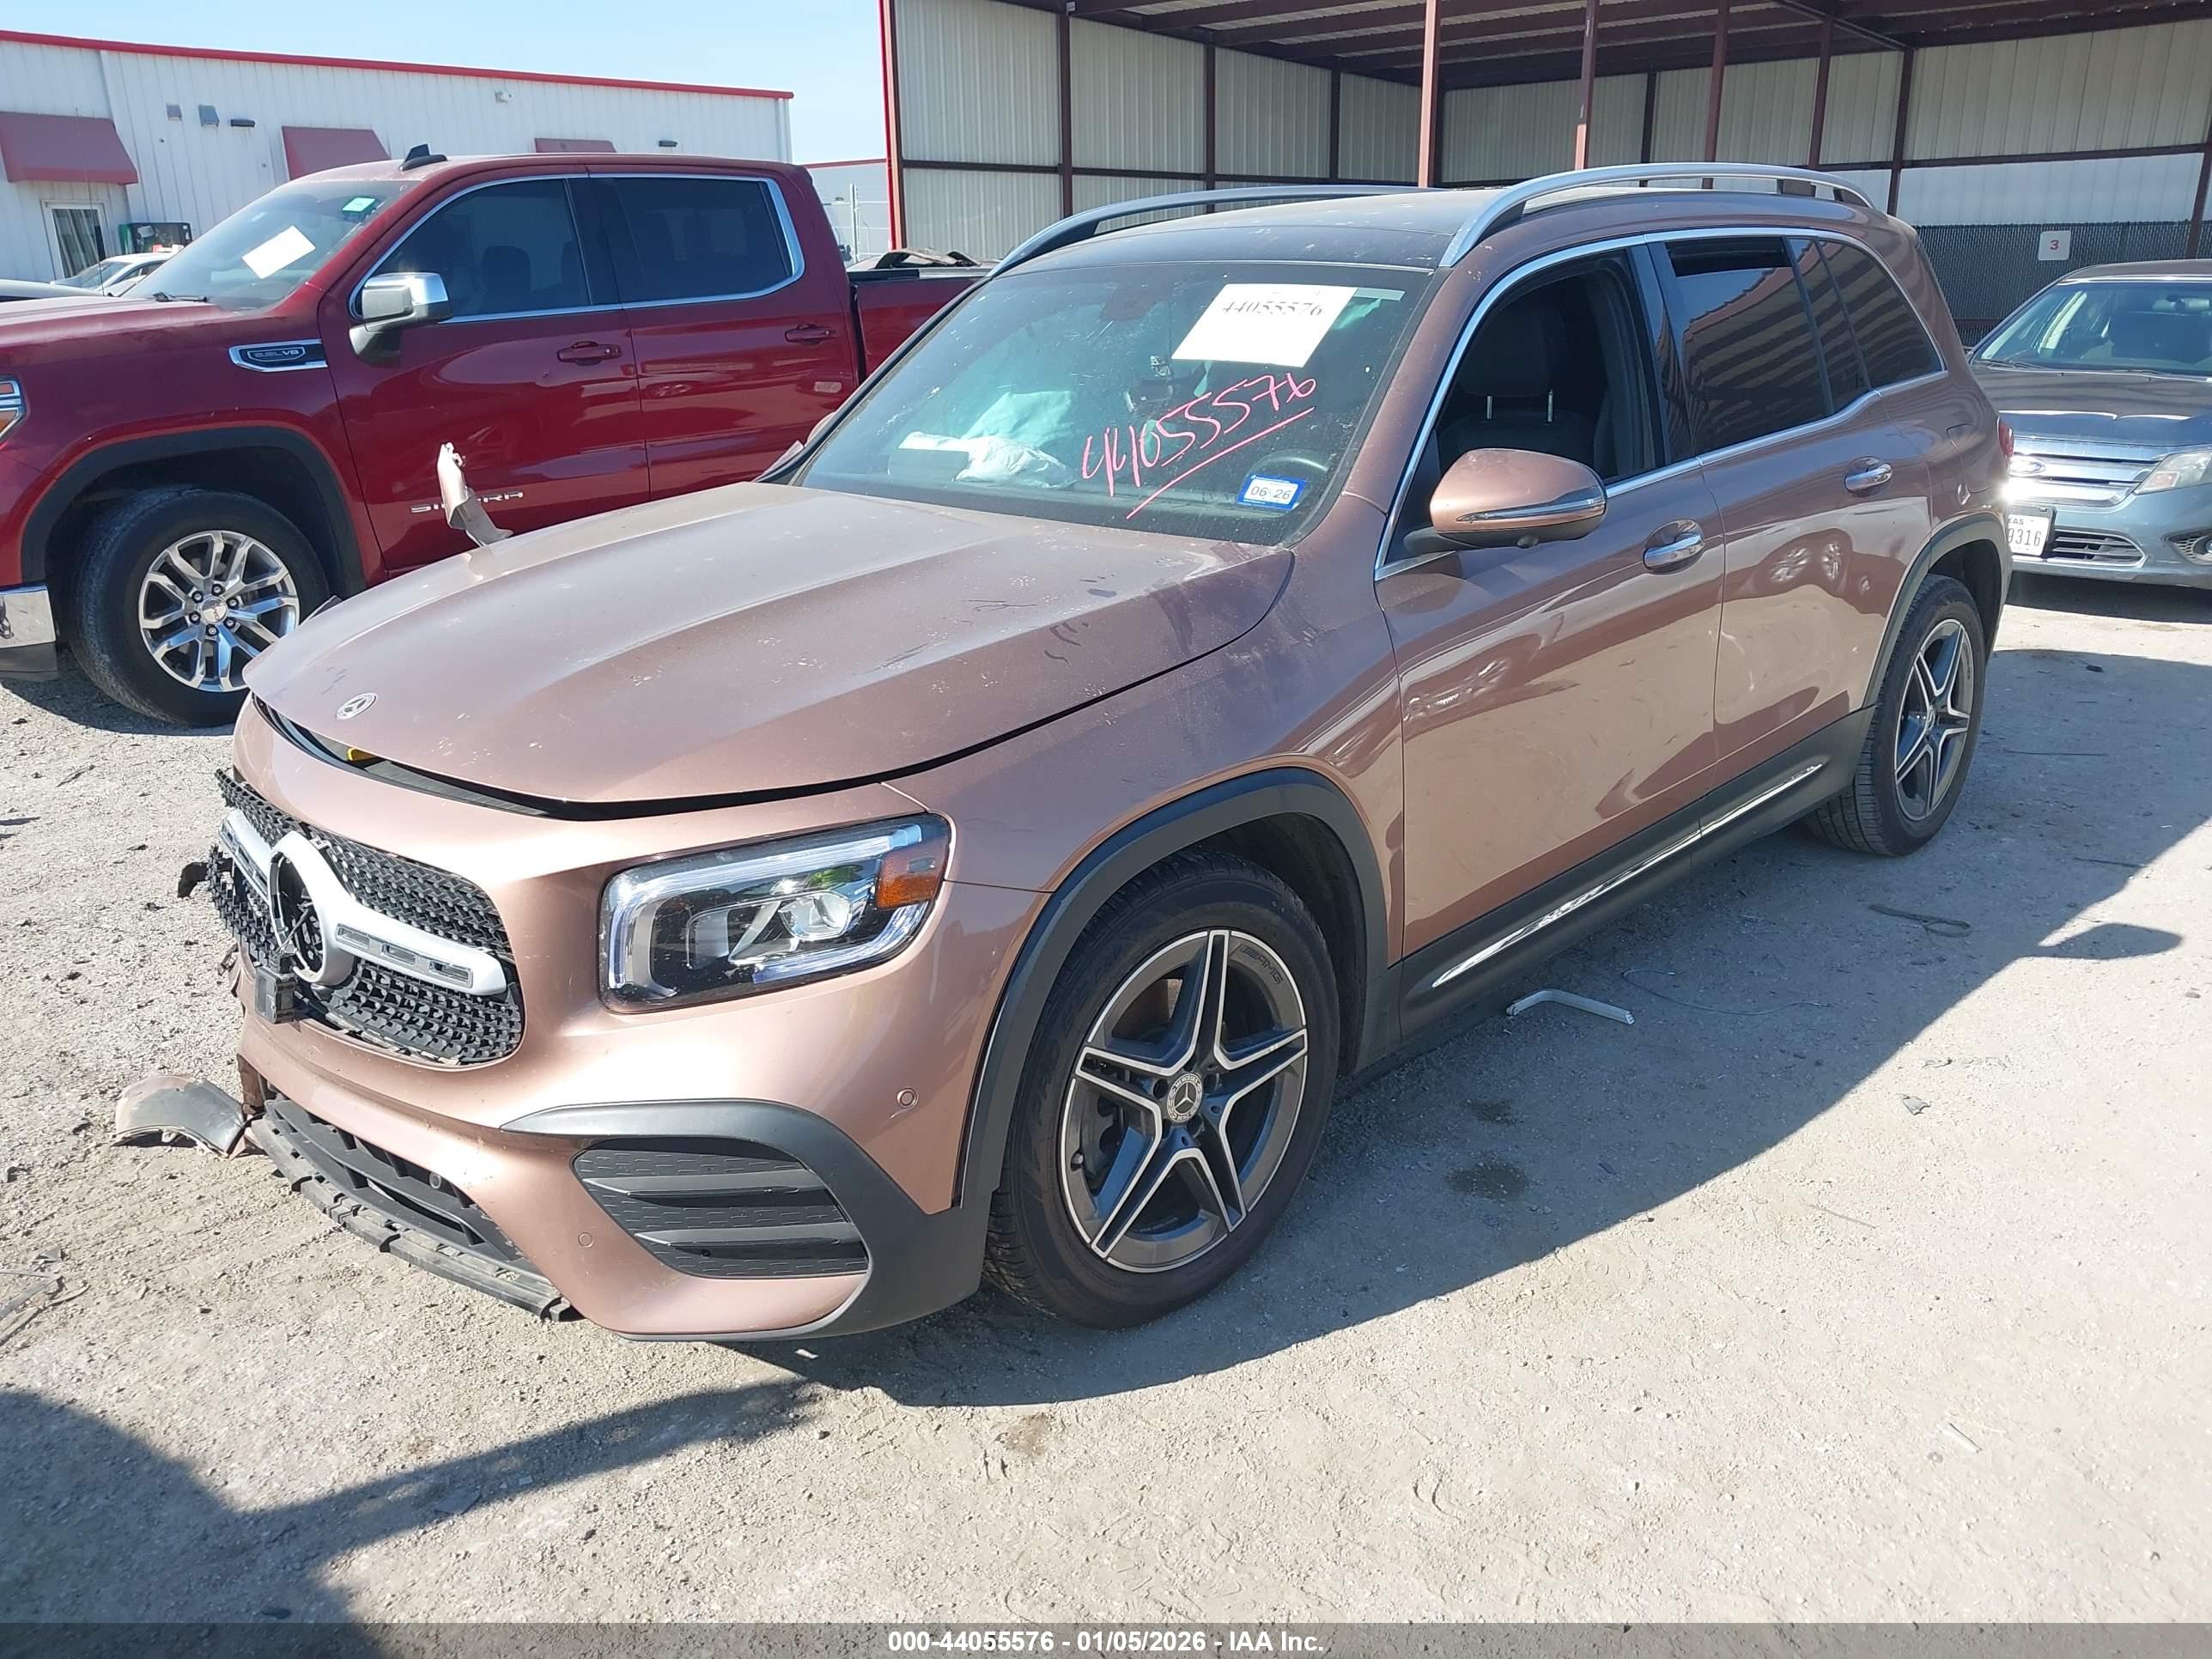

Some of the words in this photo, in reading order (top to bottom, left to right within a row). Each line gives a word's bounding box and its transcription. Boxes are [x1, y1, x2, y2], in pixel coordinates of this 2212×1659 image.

[2049, 239, 2060, 251] 3
[1082, 372, 1317, 498] 44055576
[410, 491, 524, 514] SIRA
[1250, 485, 1267, 497] 06
[1273, 489, 1292, 501] 26
